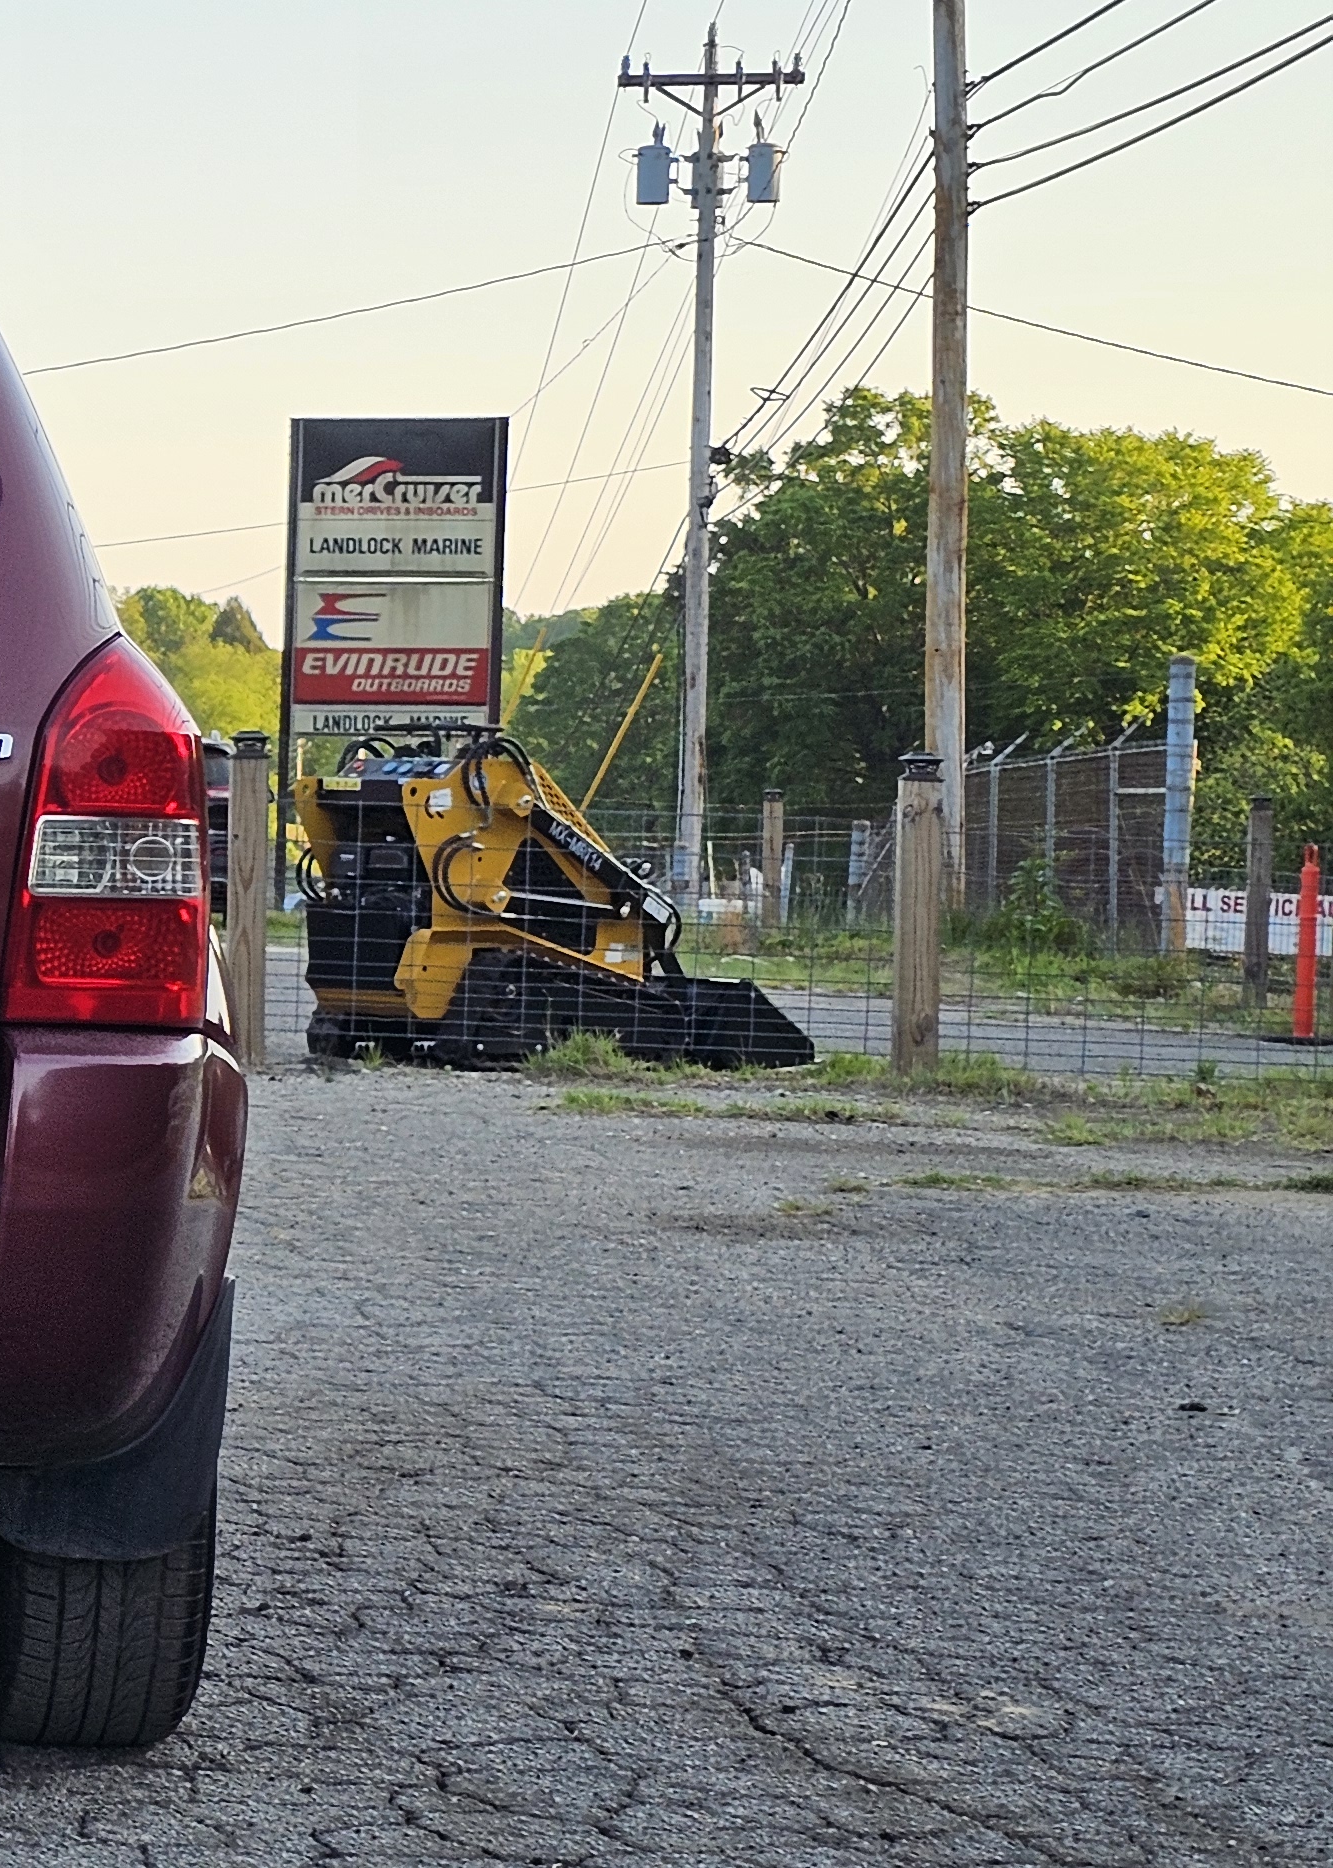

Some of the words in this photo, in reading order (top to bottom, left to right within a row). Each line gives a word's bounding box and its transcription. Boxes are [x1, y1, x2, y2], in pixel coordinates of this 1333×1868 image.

[315, 506, 355, 516] STERN
[357, 506, 402, 516] DRIVES
[404, 507, 411, 516] &
[414, 507, 478, 516] INBOARDS
[309, 537, 403, 555] LANDLOCK
[412, 538, 484, 556] MARINE
[302, 653, 480, 676] EVINRUDE
[351, 678, 471, 693] OUTBOARDS
